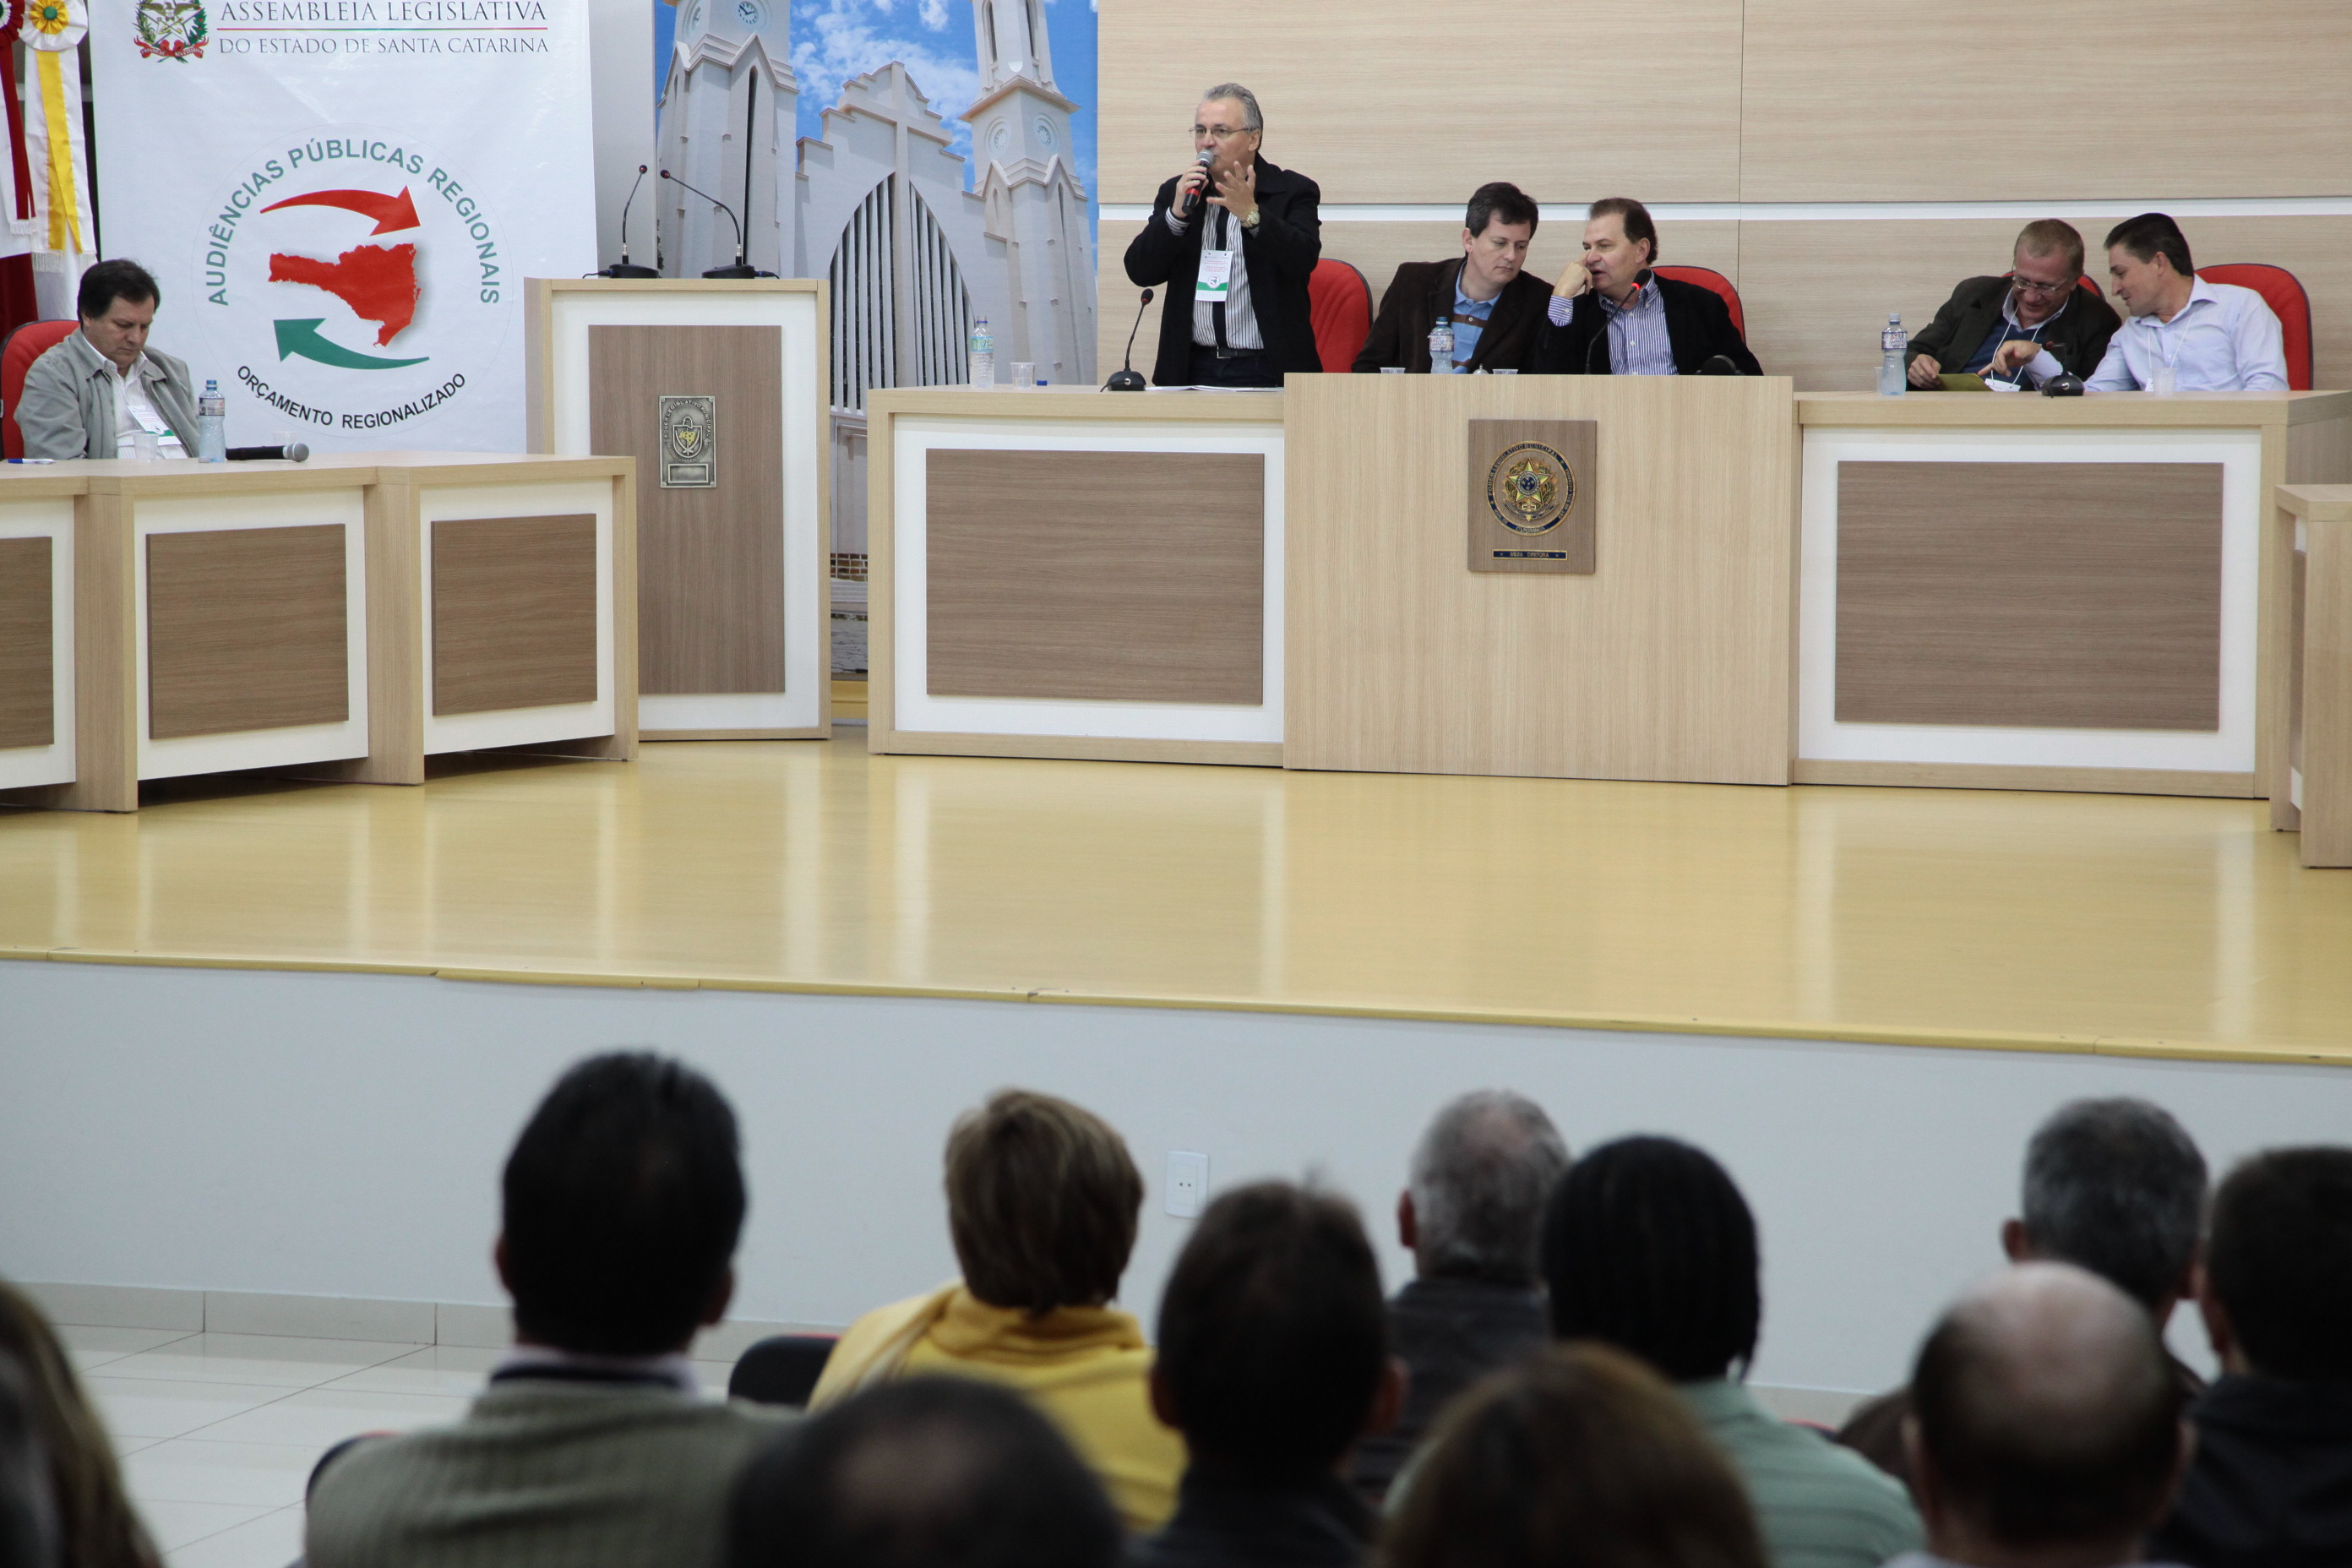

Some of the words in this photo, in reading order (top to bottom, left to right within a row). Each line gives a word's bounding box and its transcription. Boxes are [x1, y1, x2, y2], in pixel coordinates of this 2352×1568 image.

[220, 1, 378, 21] ASSEMBLEIA
[388, 1, 547, 21] LEGISLATIVA
[220, 38, 251, 53] DO
[259, 38, 337, 53] ESTADO
[346, 38, 370, 53] DE
[378, 37, 443, 53] SANTA
[448, 37, 549, 53] CATARINA
[205, 159, 285, 306] AUDIÊNCIAS
[287, 138, 424, 174] PÚBLICAS
[427, 166, 500, 304] REGIONAIS
[237, 366, 334, 426] ORÇAMENTO
[341, 373, 466, 429] REGIONALIZADO
[667, 400, 701, 417] LEGISLATIVO
[1524, 444, 1558, 458] MUNICIPAL
